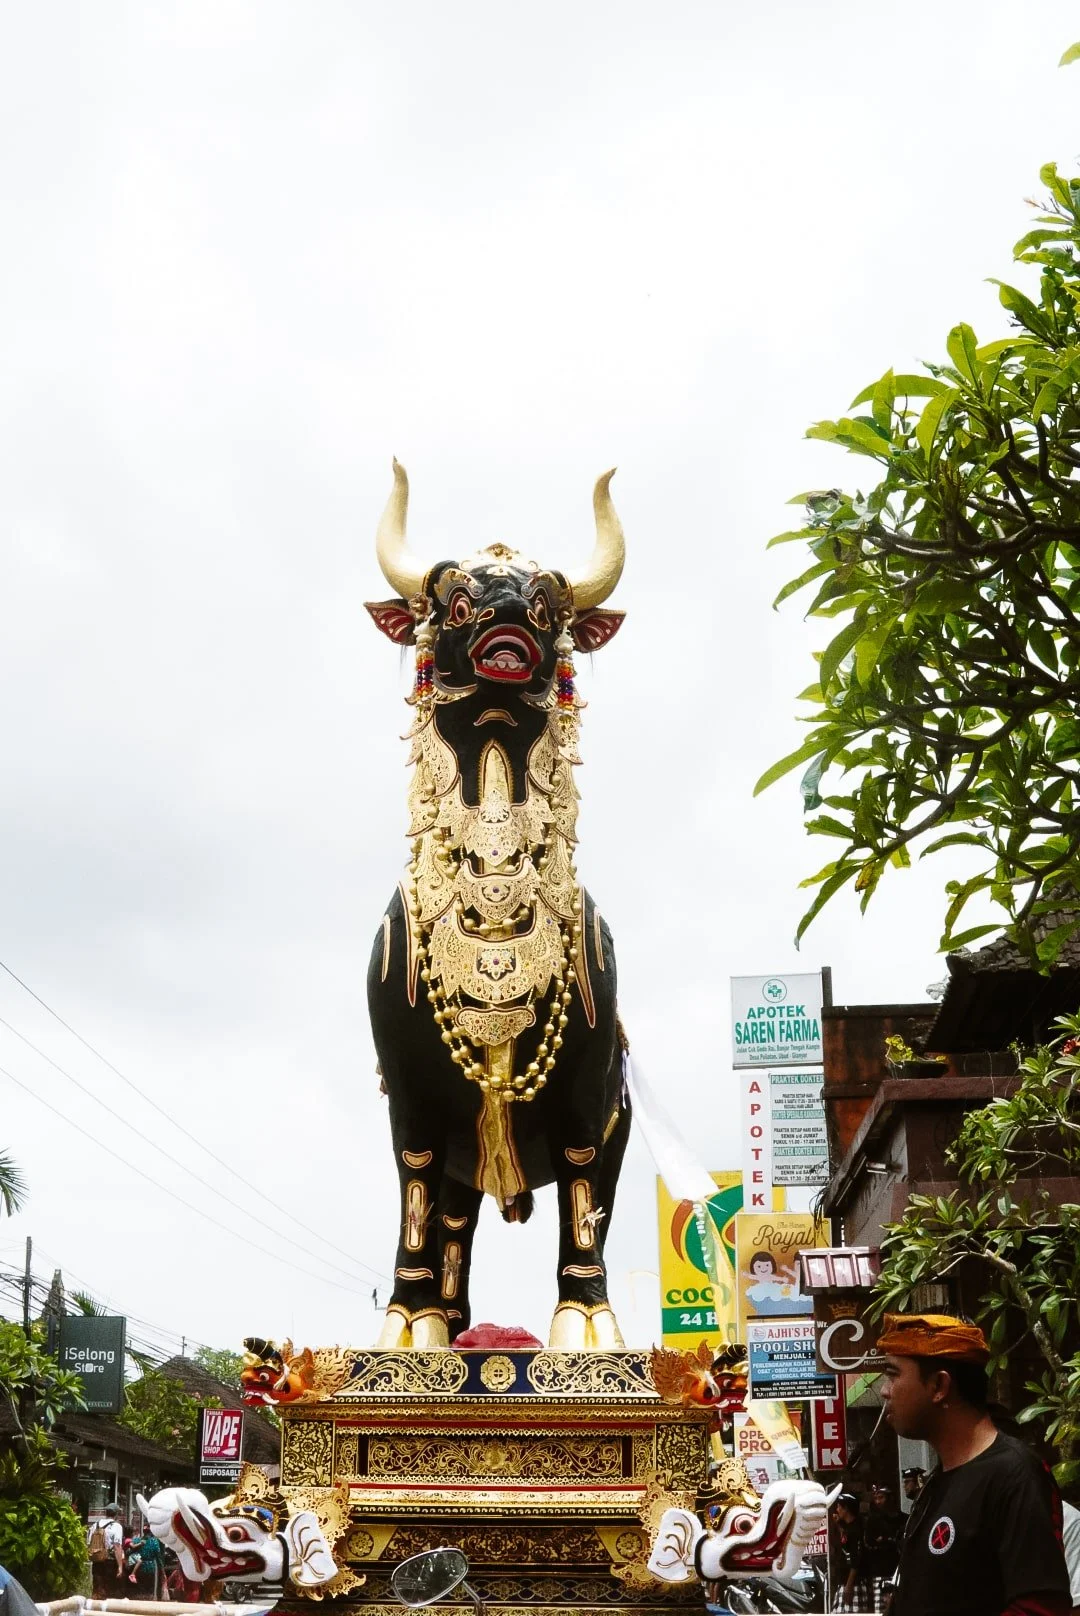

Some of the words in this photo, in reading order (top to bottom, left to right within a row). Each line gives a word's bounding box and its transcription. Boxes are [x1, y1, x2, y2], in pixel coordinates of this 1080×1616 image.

[747, 1004, 806, 1020] APOTEK
[735, 1021, 775, 1045] SAREN
[778, 1019, 821, 1042] FARMA
[749, 1081, 765, 1206] APOTEK
[752, 1224, 815, 1254] Royal
[680, 1312, 703, 1326] 24
[768, 1327, 801, 1339] AJHI'S
[753, 1342, 790, 1353] POOL
[65, 1347, 115, 1364] iSelong
[773, 1352, 807, 1361] MENJUAL
[204, 1415, 241, 1447] VAPE
[203, 1446, 221, 1454] SHOP
[739, 1439, 772, 1452] PRO
